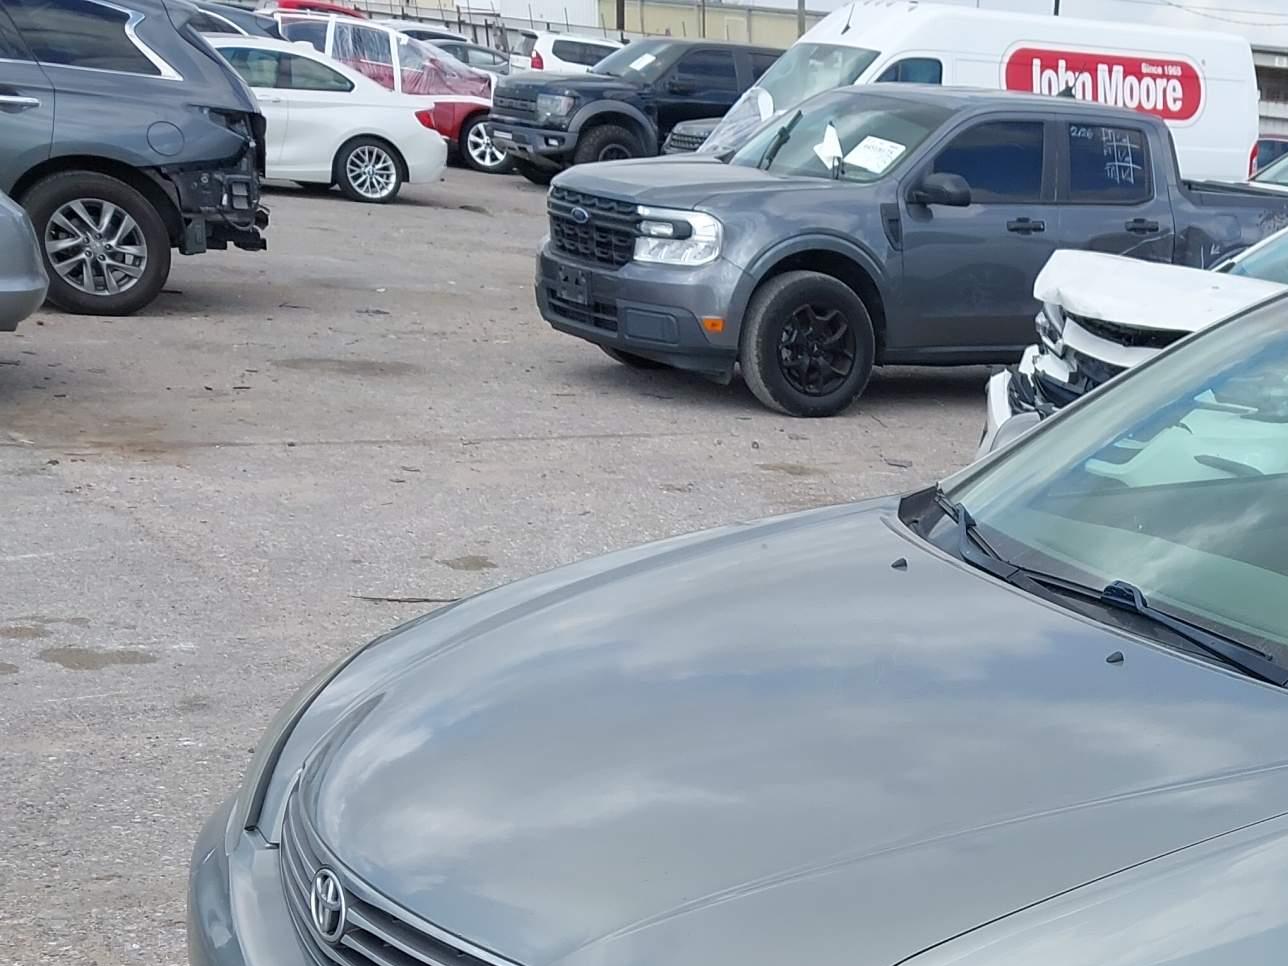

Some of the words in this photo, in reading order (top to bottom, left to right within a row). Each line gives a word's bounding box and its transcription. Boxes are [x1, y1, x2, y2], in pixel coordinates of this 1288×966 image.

[1032, 58, 1093, 101] John
[1097, 63, 1183, 112] Moore
[1141, 62, 1163, 75] Since
